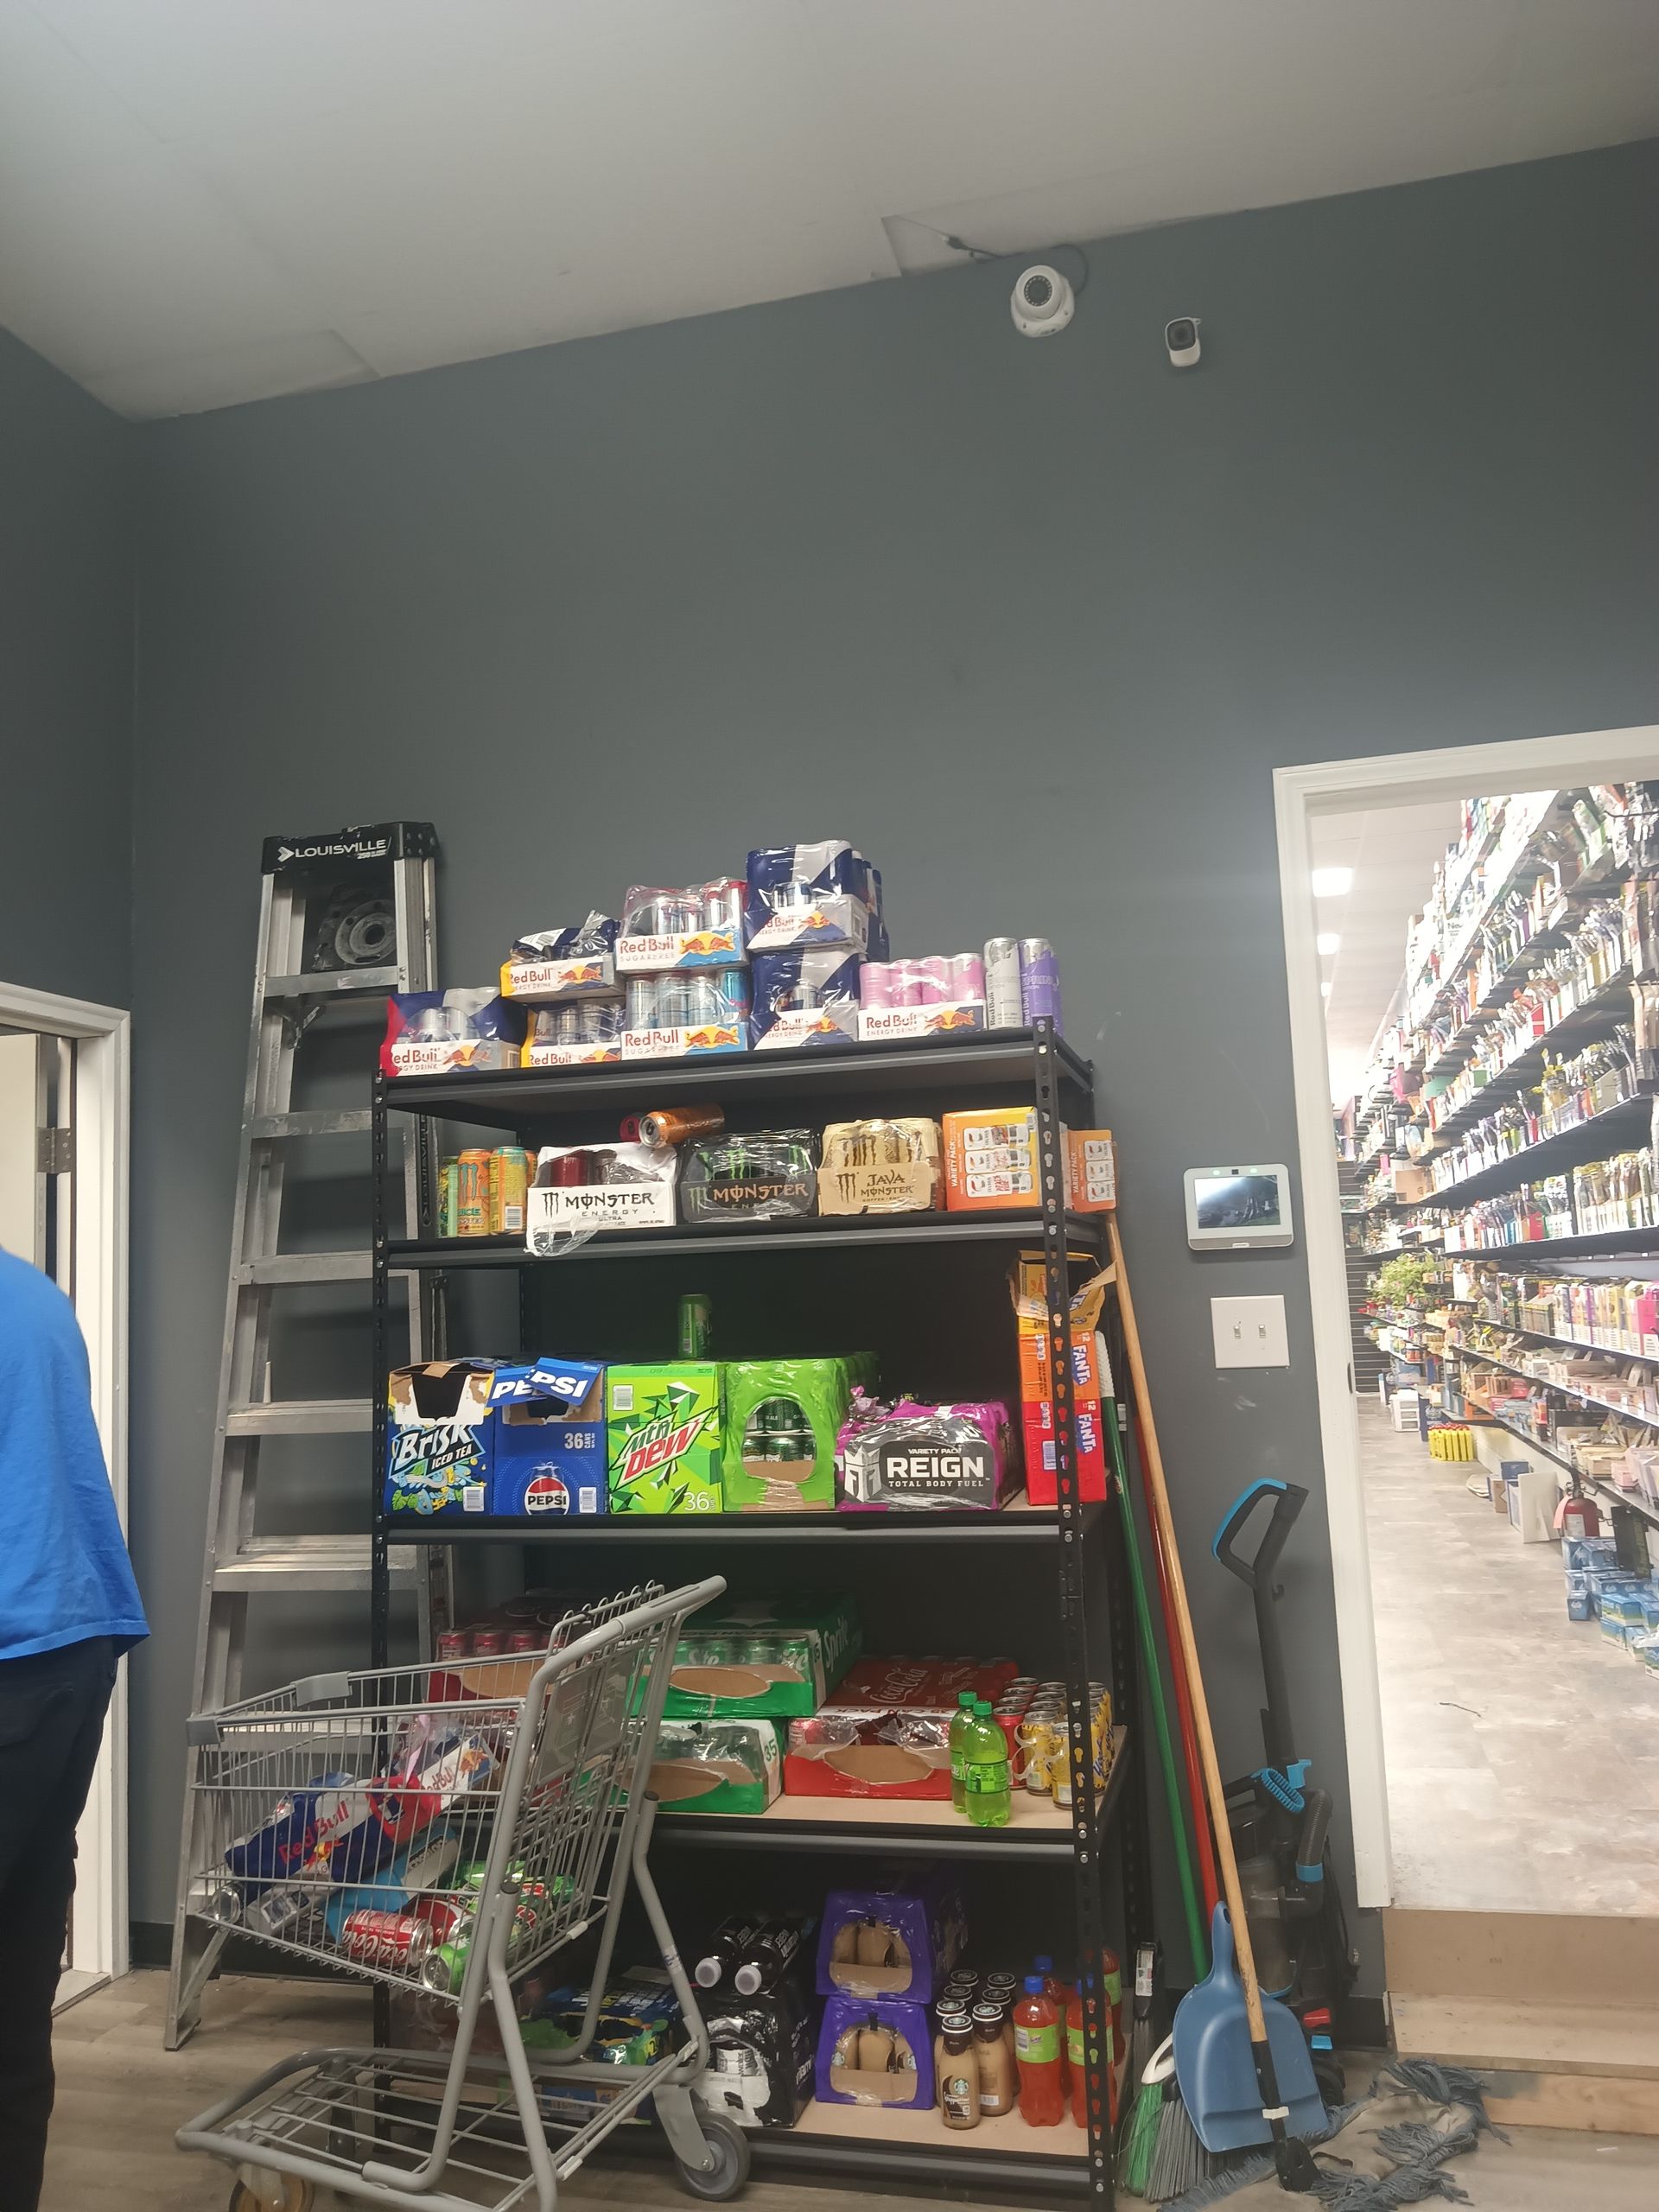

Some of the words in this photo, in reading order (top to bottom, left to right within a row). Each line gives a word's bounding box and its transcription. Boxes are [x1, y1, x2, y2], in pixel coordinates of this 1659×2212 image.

[295, 839, 387, 858] LOUISVILLE
[620, 938, 647, 954] Red
[648, 935, 674, 951] Bull
[529, 968, 551, 982] Bull
[866, 1014, 891, 1029] Red
[625, 1031, 652, 1047] Red
[653, 1029, 679, 1044] Bull
[867, 1169, 906, 1187] JAVA
[950, 1160, 959, 1188] VARIETY
[1071, 1167, 1080, 1193] VARIETY
[713, 1183, 809, 1203] MONSTER
[861, 1185, 913, 1198] MONSTER
[565, 1192, 655, 1211] MONSTER
[582, 1208, 639, 1217] ENERGY
[1072, 1344, 1091, 1385] FANTA
[1087, 1400, 1096, 1411] 12
[564, 1433, 584, 1449] 36
[1077, 1413, 1097, 1454] FANTA
[431, 1452, 454, 1470] ICED
[455, 1444, 473, 1459] TEA
[887, 1456, 984, 1478] REIGN
[527, 1495, 567, 1506] PEPSI
[683, 1491, 710, 1511] 36
[764, 1738, 778, 1762] 35
[277, 1826, 316, 1865] Red
[314, 1800, 350, 1839] Bull
